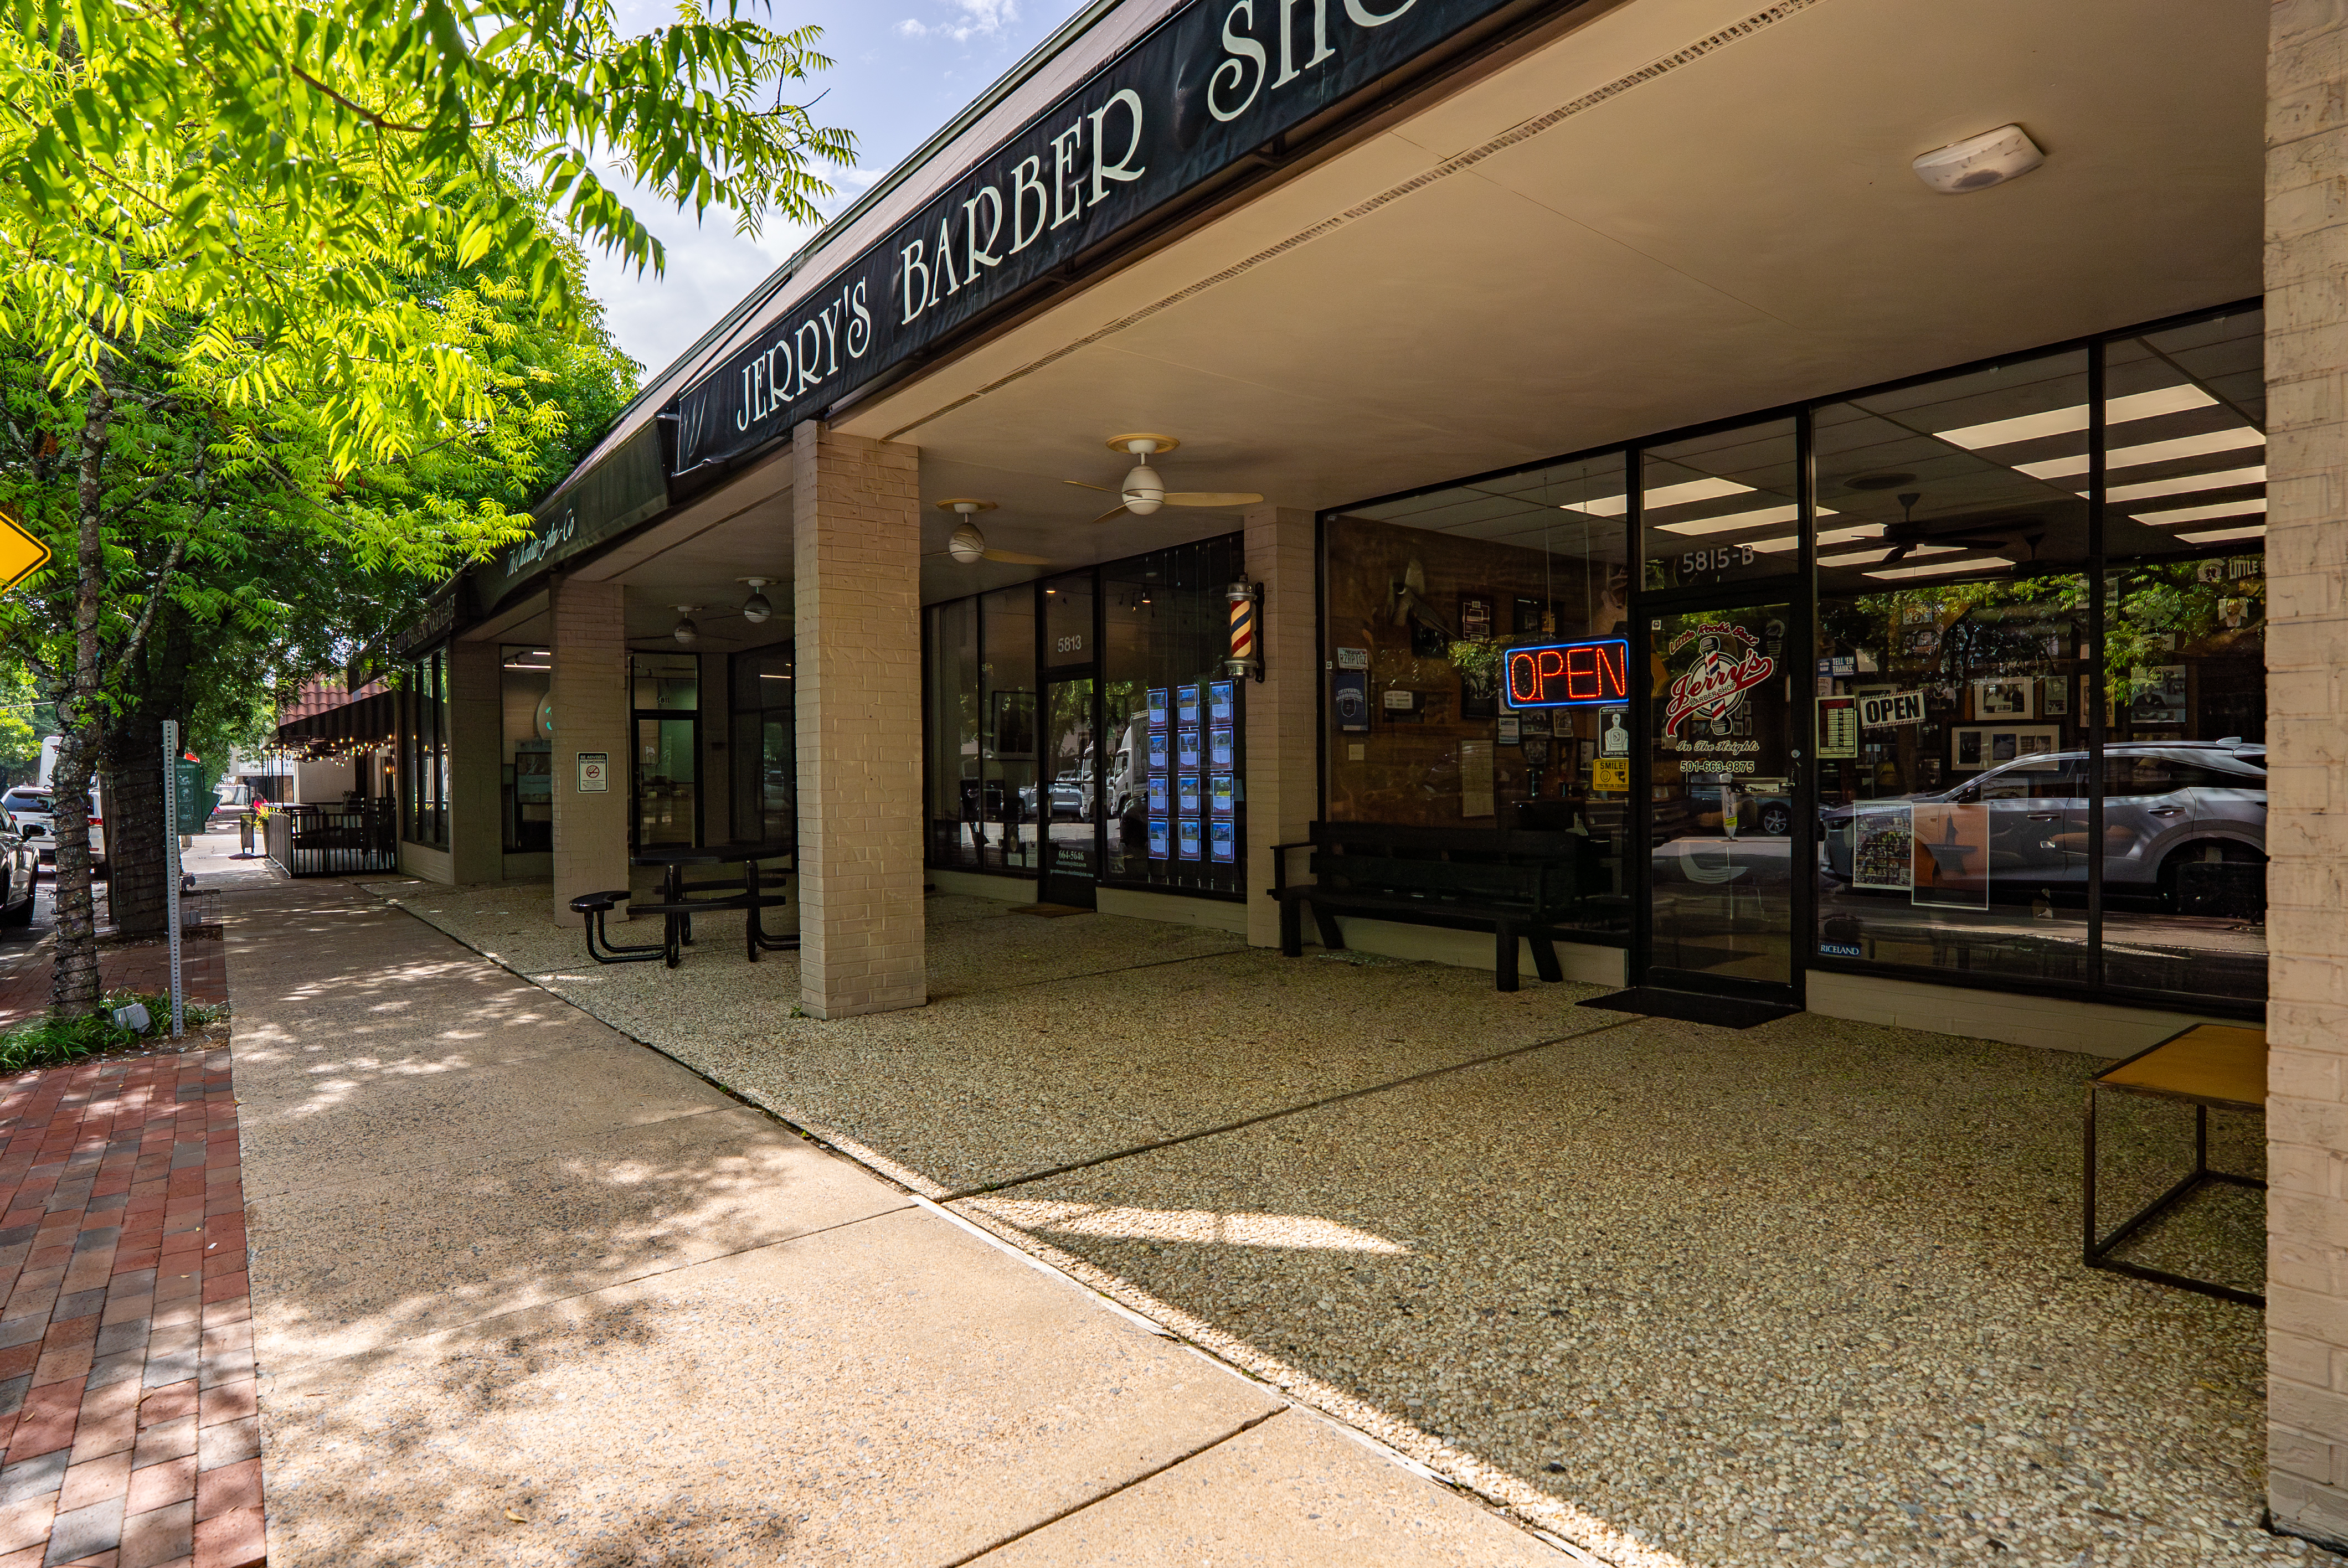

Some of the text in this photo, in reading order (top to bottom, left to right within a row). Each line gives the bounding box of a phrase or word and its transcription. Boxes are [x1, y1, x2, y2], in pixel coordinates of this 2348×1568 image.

[737, 0, 1417, 431] JERRY'S BARBER SH
[563, 508, 574, 541] Co
[1683, 544, 1754, 573] 5815-B
[2229, 559, 2258, 580] LITTLE
[1058, 635, 1082, 652] 5813
[1832, 657, 1845, 666] TELL
[1832, 666, 1854, 674] THANKS.
[1511, 645, 1625, 701] OPEN
[1666, 648, 1774, 725] Jerry's
[1690, 683, 1737, 706] BARBER SHOP
[1865, 694, 1920, 723] OPEN
[1676, 740, 1760, 756] In The Heights
[1680, 760, 1755, 773] 501-663-9875
[1820, 945, 1860, 955] RICELAND
